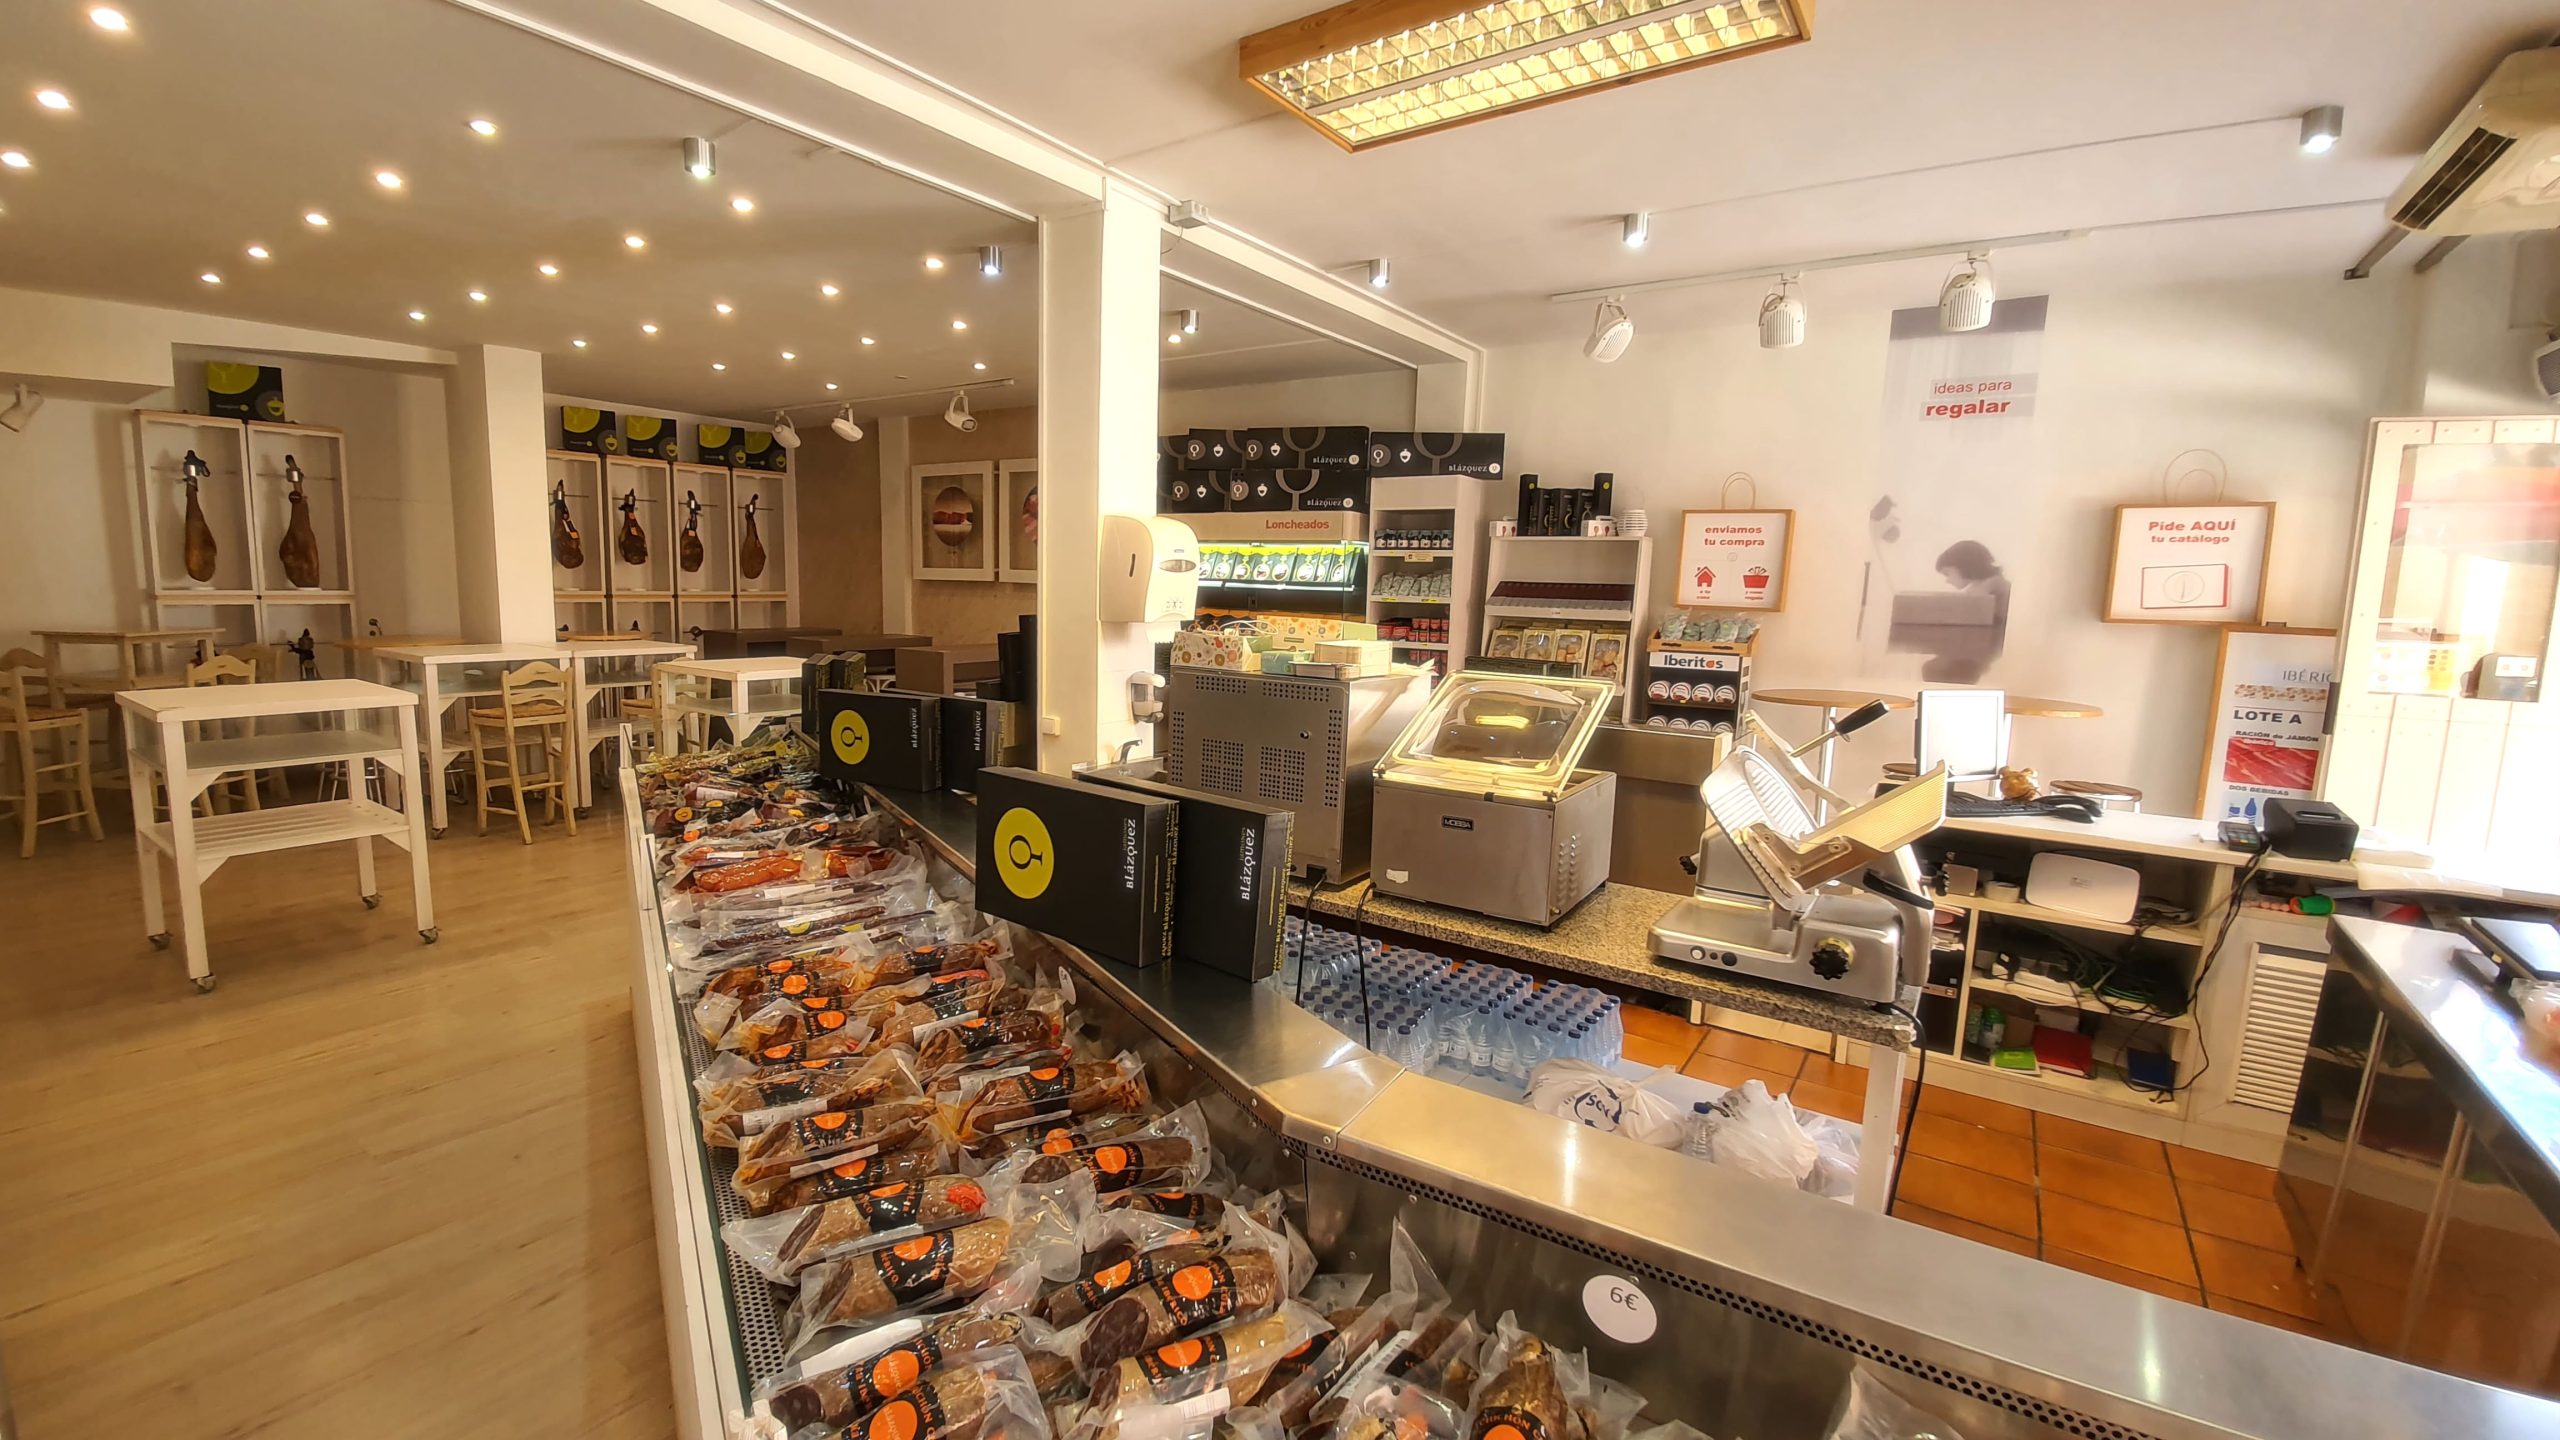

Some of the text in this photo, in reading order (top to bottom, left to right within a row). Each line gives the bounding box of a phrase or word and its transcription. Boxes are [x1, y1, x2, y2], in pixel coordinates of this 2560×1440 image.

[1934, 381, 2012, 394] ideas para
[1926, 399, 2011, 419] regalar
[1265, 519, 1330, 529] Loncheados
[2148, 518, 2236, 531] Pide AQUÍ
[1704, 538, 1765, 547] tu compra
[2151, 535, 2165, 543] tu
[2233, 709, 2302, 725] LOTE A
[2229, 784, 2289, 796] DOS BEBIDAS
[1610, 1286, 1639, 1311] 6€
